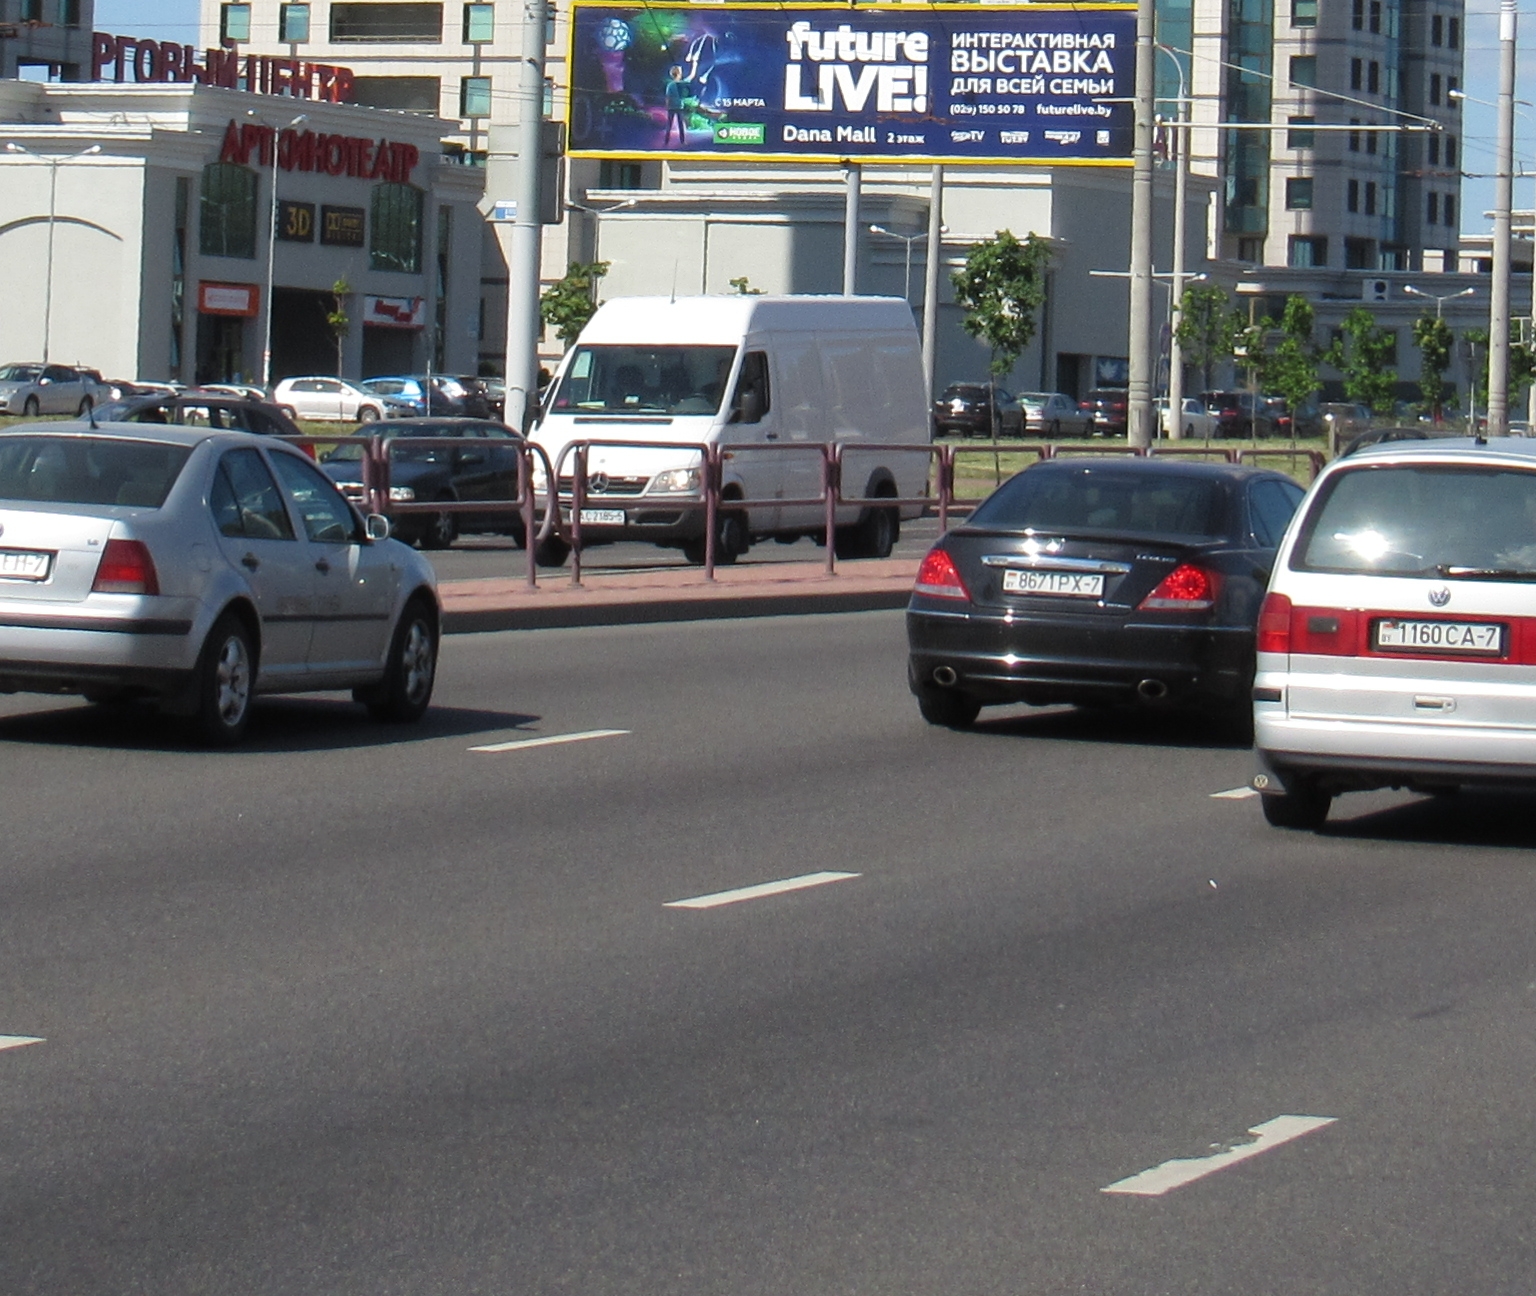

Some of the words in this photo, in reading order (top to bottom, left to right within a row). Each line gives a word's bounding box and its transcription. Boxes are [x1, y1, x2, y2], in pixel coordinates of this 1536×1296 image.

[786, 21, 929, 62] future
[952, 33, 1115, 48] ИНТЕРАКТИВНАЯ
[951, 49, 1114, 74] ВЫСТАВКА
[784, 64, 928, 113] LIVE!
[950, 78, 992, 96] ДЛЯ
[996, 74, 1045, 94] ВСЕЙ
[1050, 79, 1114, 94] СЕМЬИ
[733, 98, 766, 107] МАРТА
[979, 105, 996, 114] 150
[998, 105, 1010, 114] 50
[1013, 105, 1025, 114] 78
[1037, 104, 1112, 117] futurelive.by
[783, 124, 832, 143] Dana
[837, 125, 877, 143] Mall
[887, 132, 895, 144] 2
[896, 134, 926, 144] этаж
[286, 206, 311, 236] 3D
